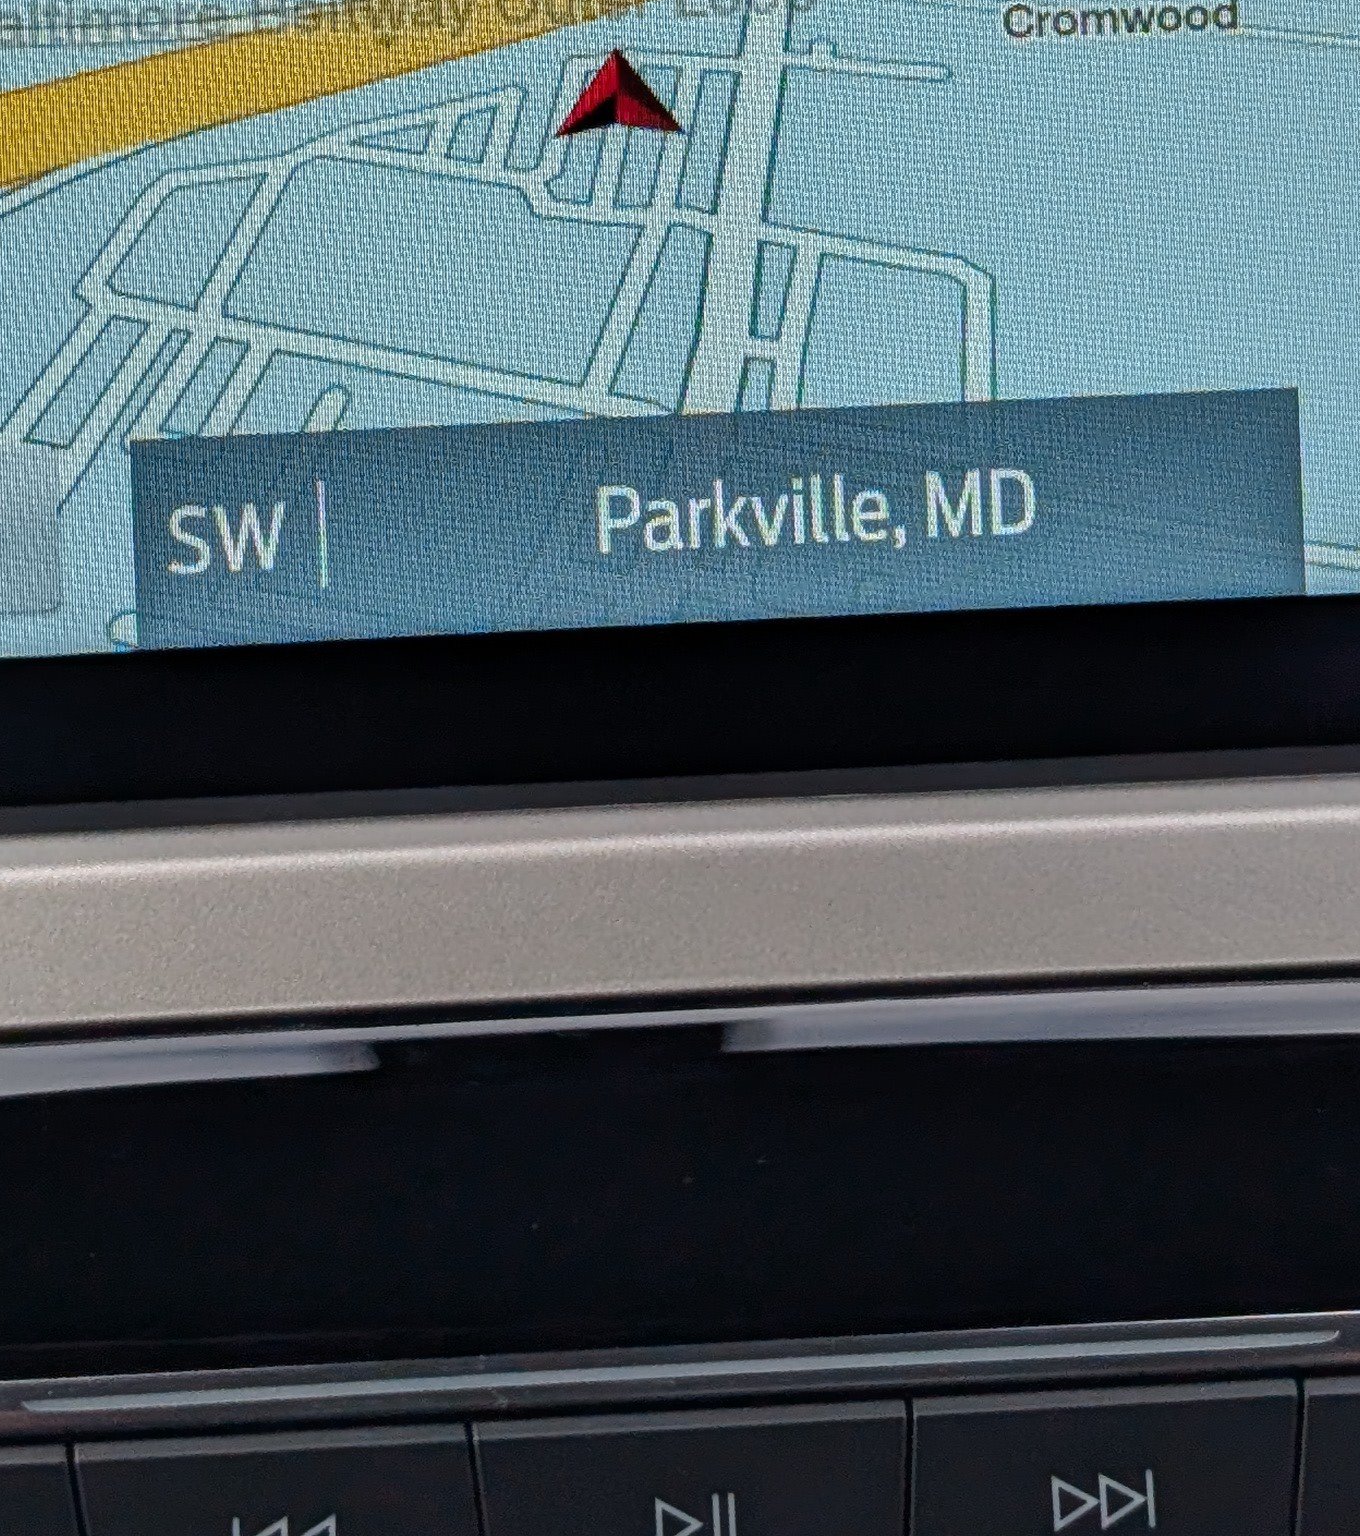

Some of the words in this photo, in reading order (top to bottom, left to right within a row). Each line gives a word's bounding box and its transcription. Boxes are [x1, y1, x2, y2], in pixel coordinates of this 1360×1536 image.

[167, 501, 286, 576] SW
[596, 472, 909, 557] Parkville,
[924, 467, 1037, 539] MD
